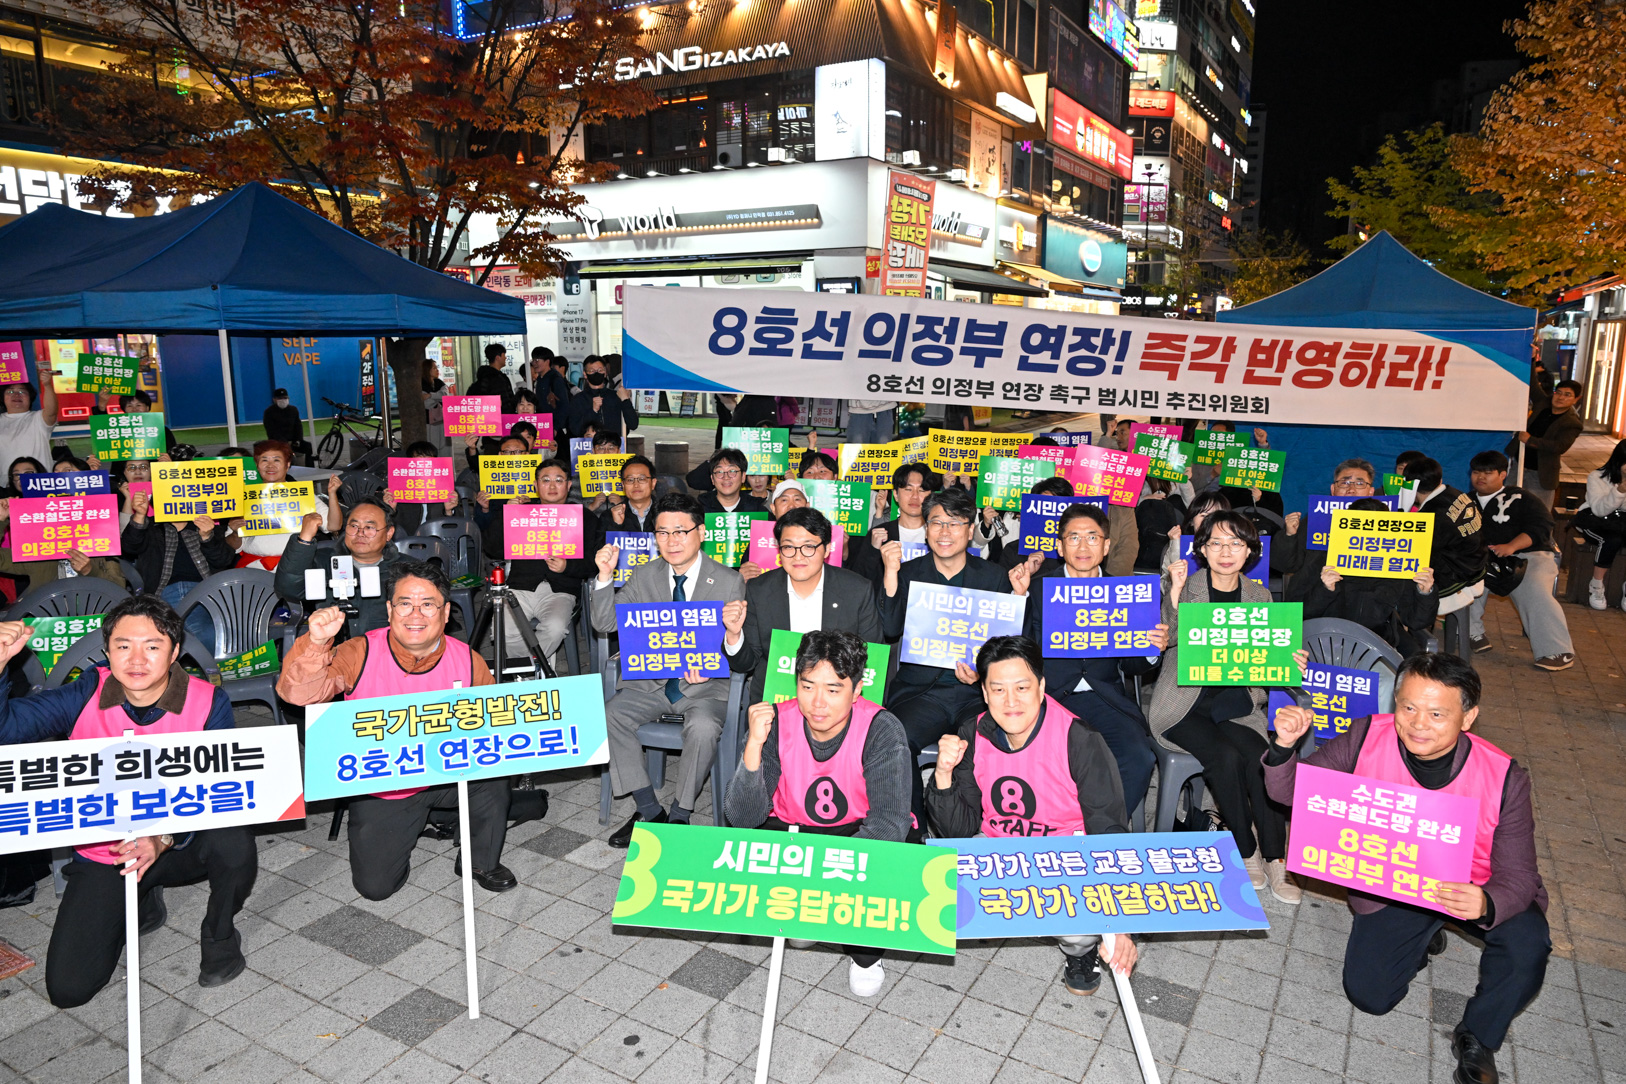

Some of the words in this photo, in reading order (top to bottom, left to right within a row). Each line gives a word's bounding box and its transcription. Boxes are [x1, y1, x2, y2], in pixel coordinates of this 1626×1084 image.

[615, 46, 702, 81] SANG
[704, 42, 790, 67] IZAKAYA
[618, 206, 677, 232] world
[932, 211, 961, 234] world
[707, 305, 852, 361] 8호선
[857, 311, 1009, 369] 의정부
[1016, 322, 1133, 376] 연장!
[1138, 331, 1238, 384] 즉각
[1242, 337, 1452, 391] 반영하라!
[95, 357, 123, 367] 8호선
[363, 362, 371, 373] 2F
[83, 365, 134, 378] 의정부연장
[866, 374, 926, 395] 8호선
[931, 377, 995, 399] 의정부
[1001, 381, 1044, 402] 연장
[1048, 384, 1092, 405] 촉구
[1097, 386, 1160, 410] 범시민
[1165, 391, 1270, 415] 추진위원회
[109, 415, 143, 427] 8호선
[459, 415, 485, 424] 8호선
[96, 427, 159, 440] 의정부연장
[449, 425, 476, 434] 의정부
[478, 424, 497, 434] 연장
[111, 440, 121, 449] 더
[124, 439, 145, 448] 이상
[933, 435, 955, 445] 8호선
[956, 436, 987, 445] 연장으로
[1209, 433, 1235, 442] 8호선
[134, 448, 160, 458] 없다!
[939, 447, 978, 459] 의정부의
[1102, 452, 1129, 465] 수도권
[1240, 449, 1269, 461] 8호선
[408, 460, 432, 468] 수도권
[483, 459, 505, 468] 8호선
[582, 459, 602, 468] 8호선
[850, 462, 890, 472] 의정부의
[933, 460, 960, 471] 미래를
[999, 461, 1035, 474] 8호선
[1080, 458, 1125, 471] 순환철도망
[1126, 466, 1143, 477] 완성
[1227, 458, 1279, 473] 의정부연장
[158, 468, 192, 480] 8호선
[195, 466, 238, 479] 연장으로
[434, 468, 449, 476] 완성
[491, 472, 530, 482] 의정부의
[27, 477, 70, 491] 시민의
[73, 475, 104, 489] 염원
[406, 479, 436, 489] 8호선
[1092, 473, 1127, 489] 8호선
[1254, 480, 1275, 490] 없다!
[172, 482, 228, 498] 의정부의
[270, 487, 308, 497] 연장으로
[394, 490, 426, 500] 의정부
[428, 489, 449, 500] 연장
[1113, 490, 1134, 503] 연장
[46, 500, 84, 511] 수도권
[164, 501, 208, 515] 미래를
[211, 499, 236, 513] 열자
[251, 501, 300, 515] 의정부의
[530, 508, 558, 517] 수도권
[19, 512, 83, 523] 순환철도망
[86, 509, 110, 520] 완성
[510, 518, 557, 528] 순환철도망
[559, 518, 578, 527] 완성
[715, 515, 750, 528] 8호선
[42, 523, 90, 540] 8호선
[1339, 518, 1374, 531] 8호선
[1378, 520, 1427, 533] 연장으로
[527, 530, 561, 542] 8호선
[22, 542, 73, 556] 의정부
[78, 538, 111, 553] 연장
[511, 545, 549, 556] 의정부
[552, 544, 576, 556] 연장
[1348, 536, 1413, 553] 의정부의
[1336, 555, 1384, 571] 미래를
[1388, 557, 1420, 572] 열자
[1050, 584, 1110, 605] 시민의
[1115, 582, 1153, 603] 염원
[914, 591, 973, 615] 시민의
[978, 599, 1017, 623] 염원
[624, 609, 677, 628] 시민의
[682, 608, 718, 627] 염원
[1074, 608, 1129, 628] 8호선
[1212, 606, 1269, 626] 8호선
[936, 617, 989, 642] 8호선
[1187, 628, 1293, 647] 의정부연장
[648, 631, 697, 649] 8호선
[1050, 631, 1109, 651] 의정부
[1113, 630, 1151, 649] 연장
[908, 637, 967, 661] 의정부
[1211, 649, 1228, 664] 더
[1232, 648, 1268, 664] 이상
[627, 653, 681, 672] 의정부
[685, 652, 721, 671] 연장
[1189, 665, 1223, 682] 미룰
[1227, 666, 1244, 682] 수
[1249, 666, 1291, 682] 없다!
[1335, 674, 1371, 695] 염원
[352, 689, 562, 741] 국가균형발전!
[114, 742, 265, 781] 희생에는
[337, 744, 426, 782] 8호선
[438, 725, 579, 771] 연장으로!
[814, 780, 838, 819] 8
[999, 779, 1026, 815] 8
[1351, 784, 1418, 814] 수도권
[0, 792, 119, 836] 특별한
[130, 780, 256, 822] 보상을!
[1307, 794, 1413, 834] 순환철도망
[1416, 818, 1461, 845] 완성
[1337, 827, 1419, 869] 8호선
[712, 840, 815, 878] 시민의
[822, 847, 869, 882] 뜻!
[957, 853, 1031, 880] 국가가
[1034, 851, 1088, 877] 만든
[1090, 849, 1144, 875] 교통
[1146, 846, 1225, 874] 불균형
[1301, 845, 1385, 886] 의정부
[662, 878, 760, 918] 국가가
[765, 886, 911, 932] 응답하라!
[979, 884, 1077, 919] 국가가
[1081, 880, 1222, 916] 해결하라!
